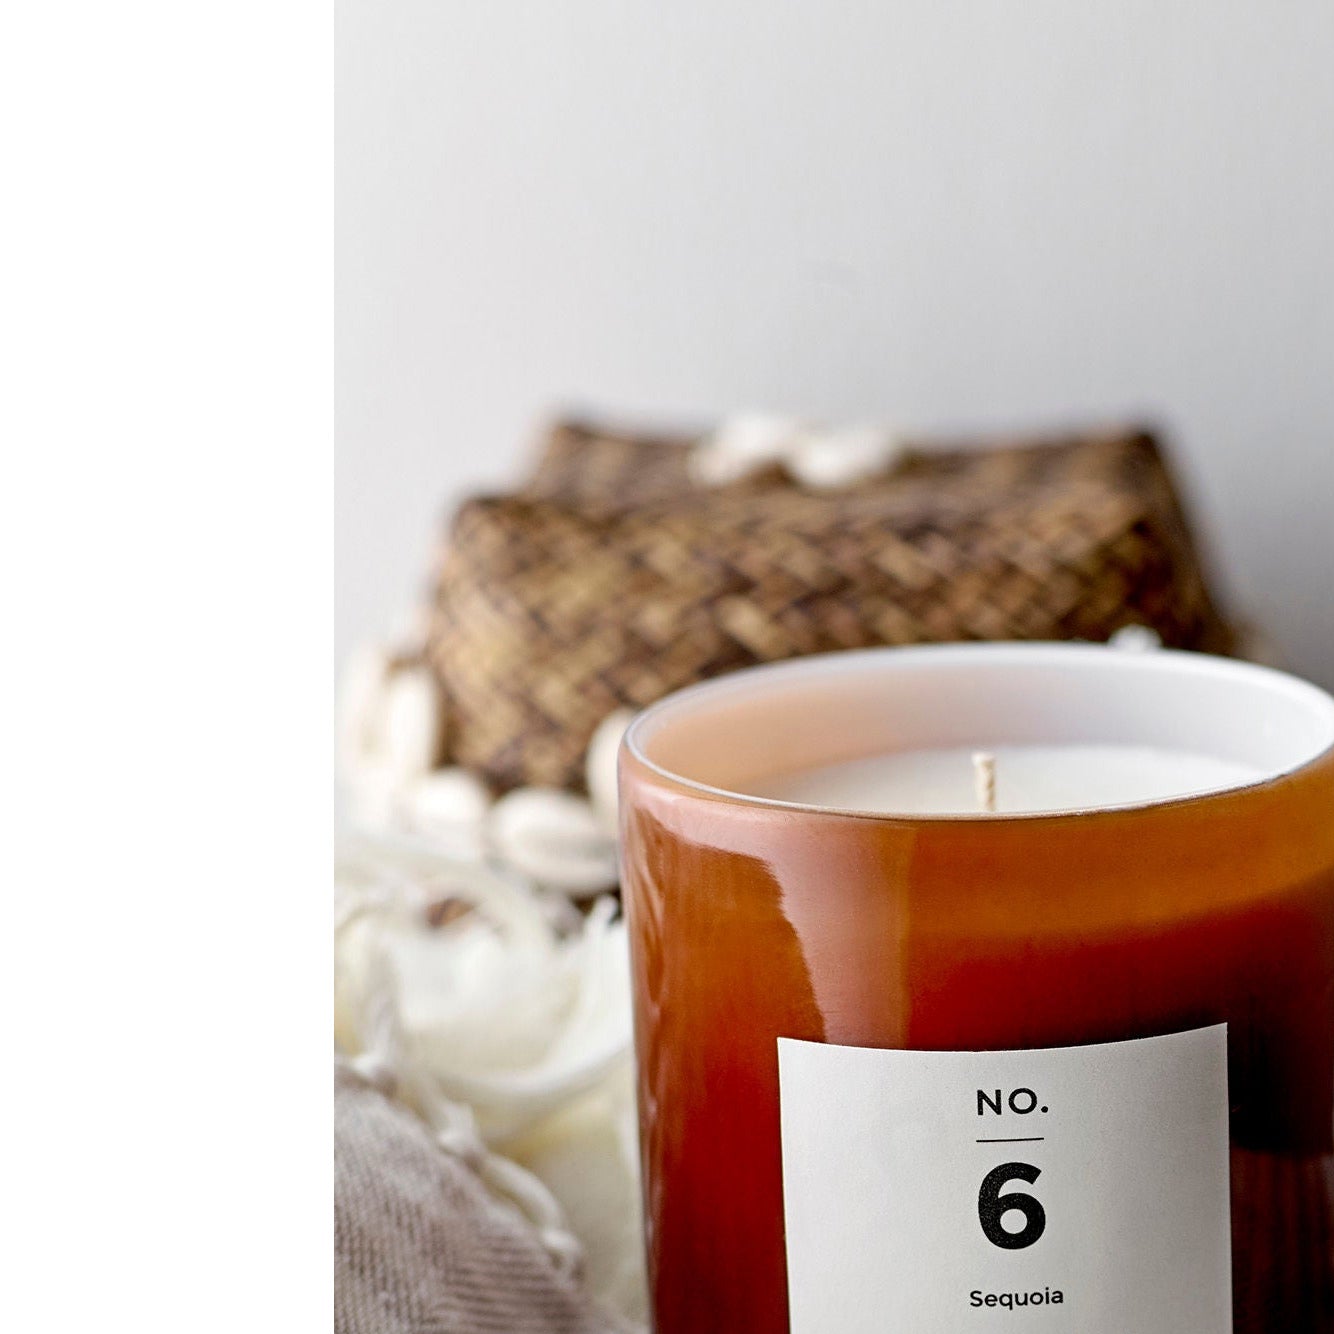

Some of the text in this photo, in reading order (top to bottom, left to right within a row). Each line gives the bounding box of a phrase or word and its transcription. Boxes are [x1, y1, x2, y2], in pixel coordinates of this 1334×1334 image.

[977, 1087, 1049, 1115] NO.
[978, 1162, 1046, 1250] 6
[969, 1287, 1064, 1311] Sequoia
